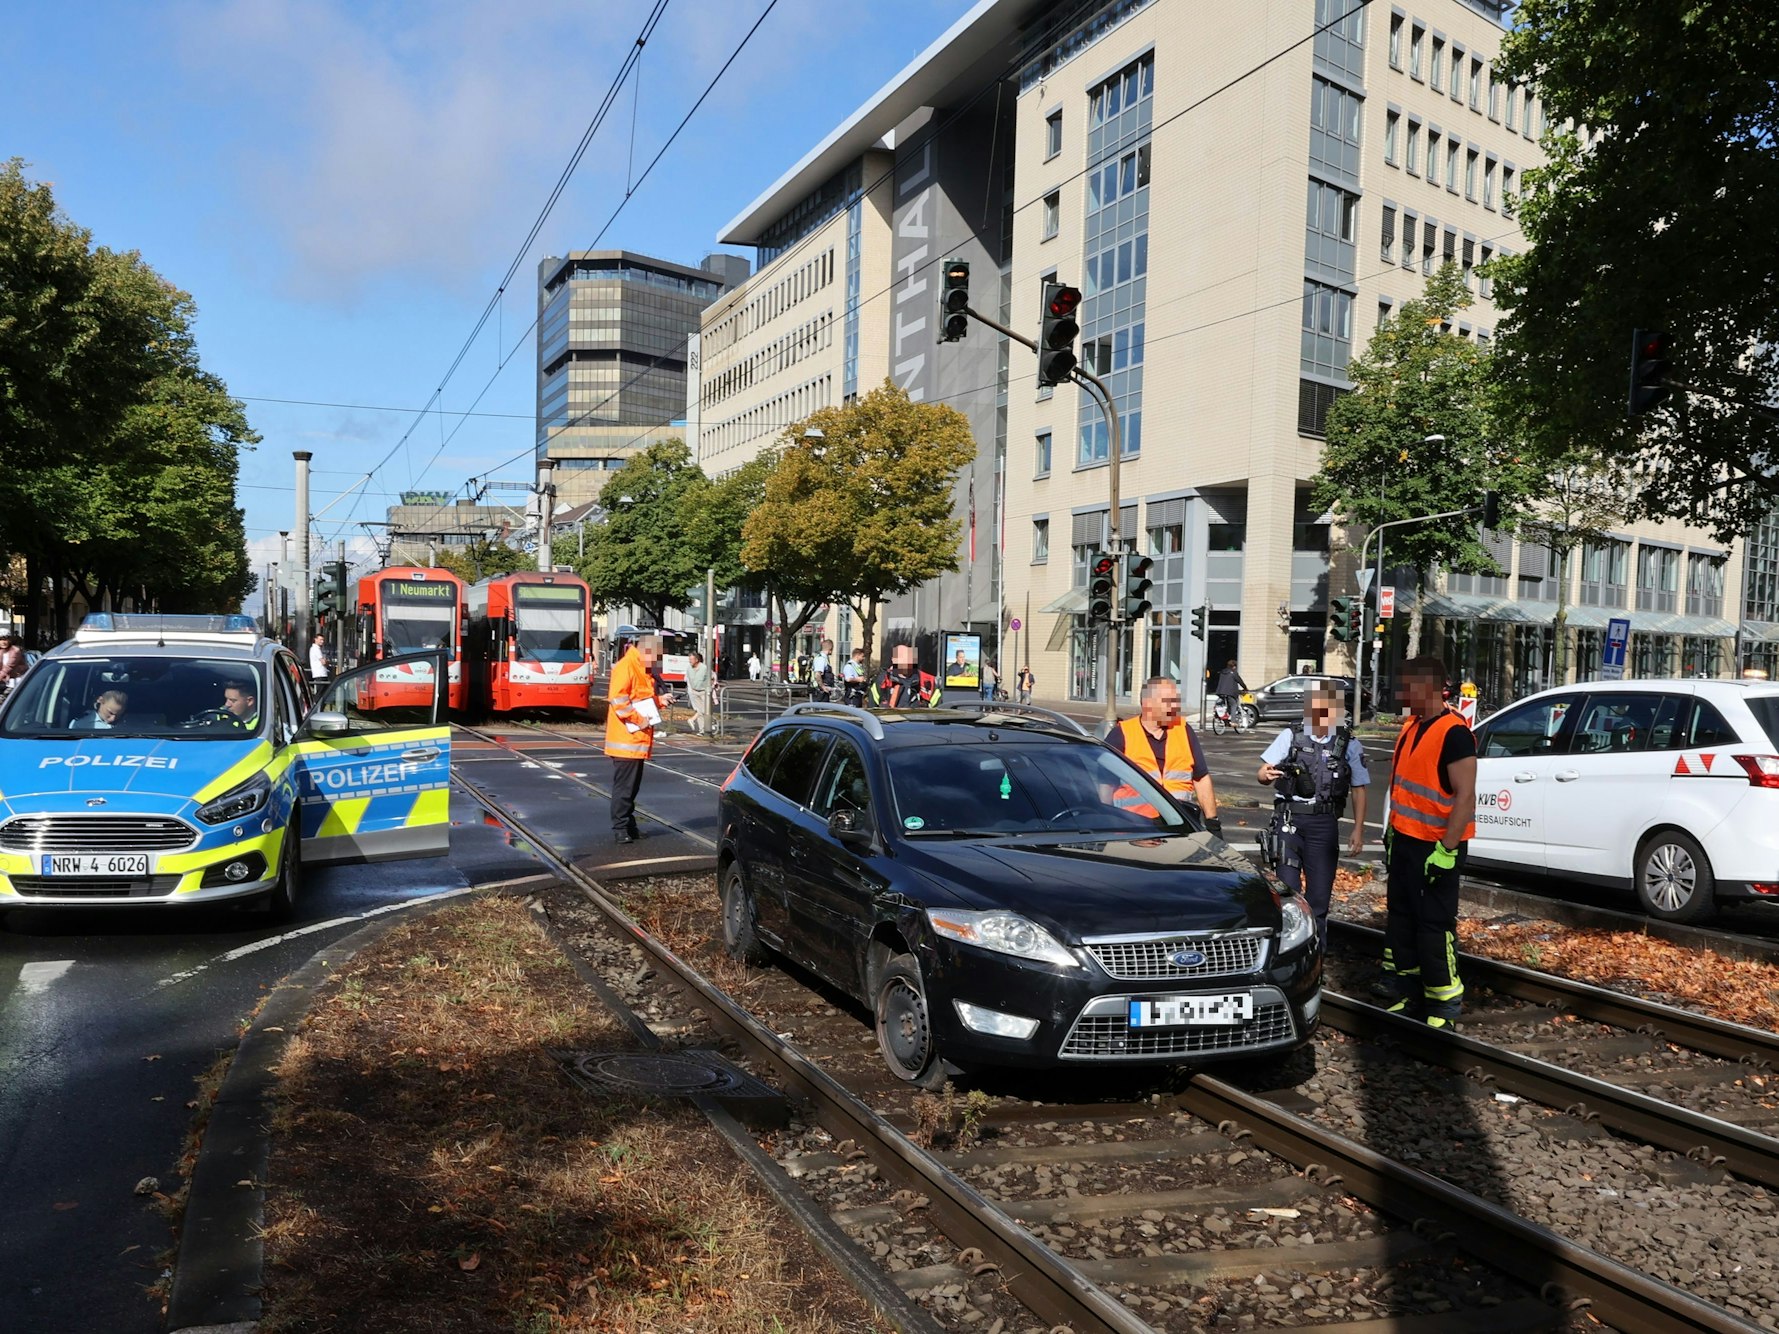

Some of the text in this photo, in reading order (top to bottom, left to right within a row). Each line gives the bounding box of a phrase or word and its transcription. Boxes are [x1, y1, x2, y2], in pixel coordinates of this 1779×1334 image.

[690, 351, 699, 370] 222
[391, 583, 450, 597] 1 Neumarkt
[38, 755, 178, 770] POLIZEI
[309, 762, 409, 791] POLIZEI
[1478, 793, 1497, 806] KVB
[52, 857, 80, 872] NRW
[90, 857, 99, 872] 4
[108, 857, 145, 872] 6026
